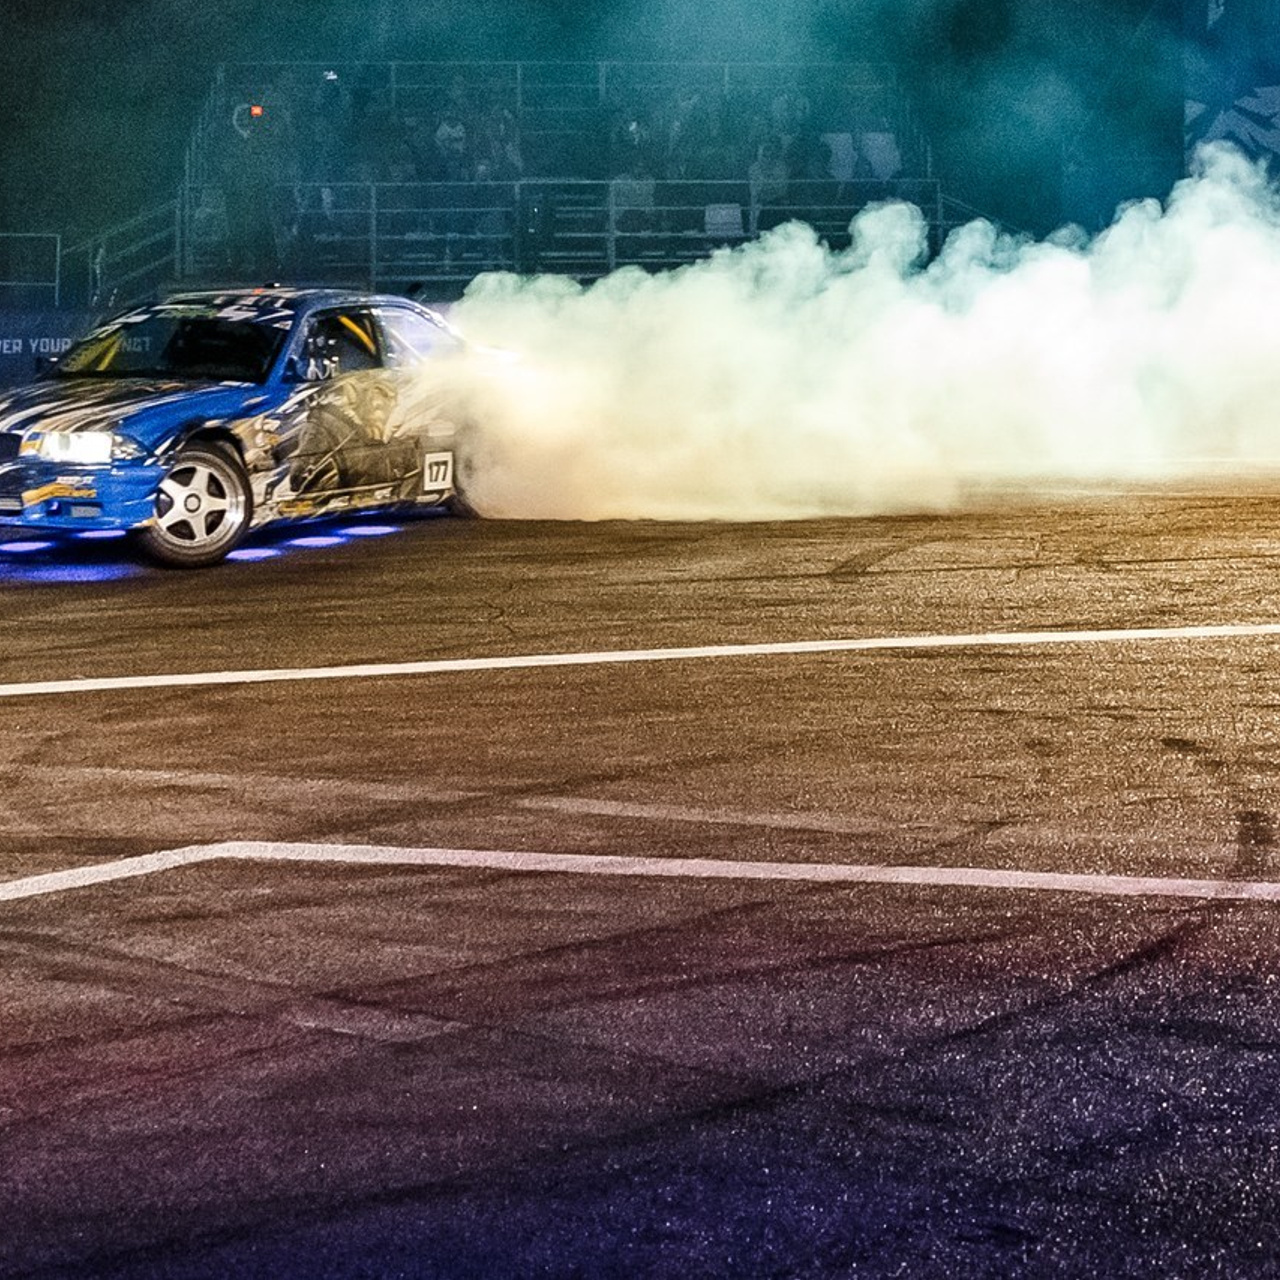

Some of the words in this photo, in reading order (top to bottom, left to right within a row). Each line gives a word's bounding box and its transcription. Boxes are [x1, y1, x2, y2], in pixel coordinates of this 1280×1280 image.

[0, 338, 23, 354] ER
[29, 337, 72, 353] YOUR
[428, 459, 449, 483] 177
